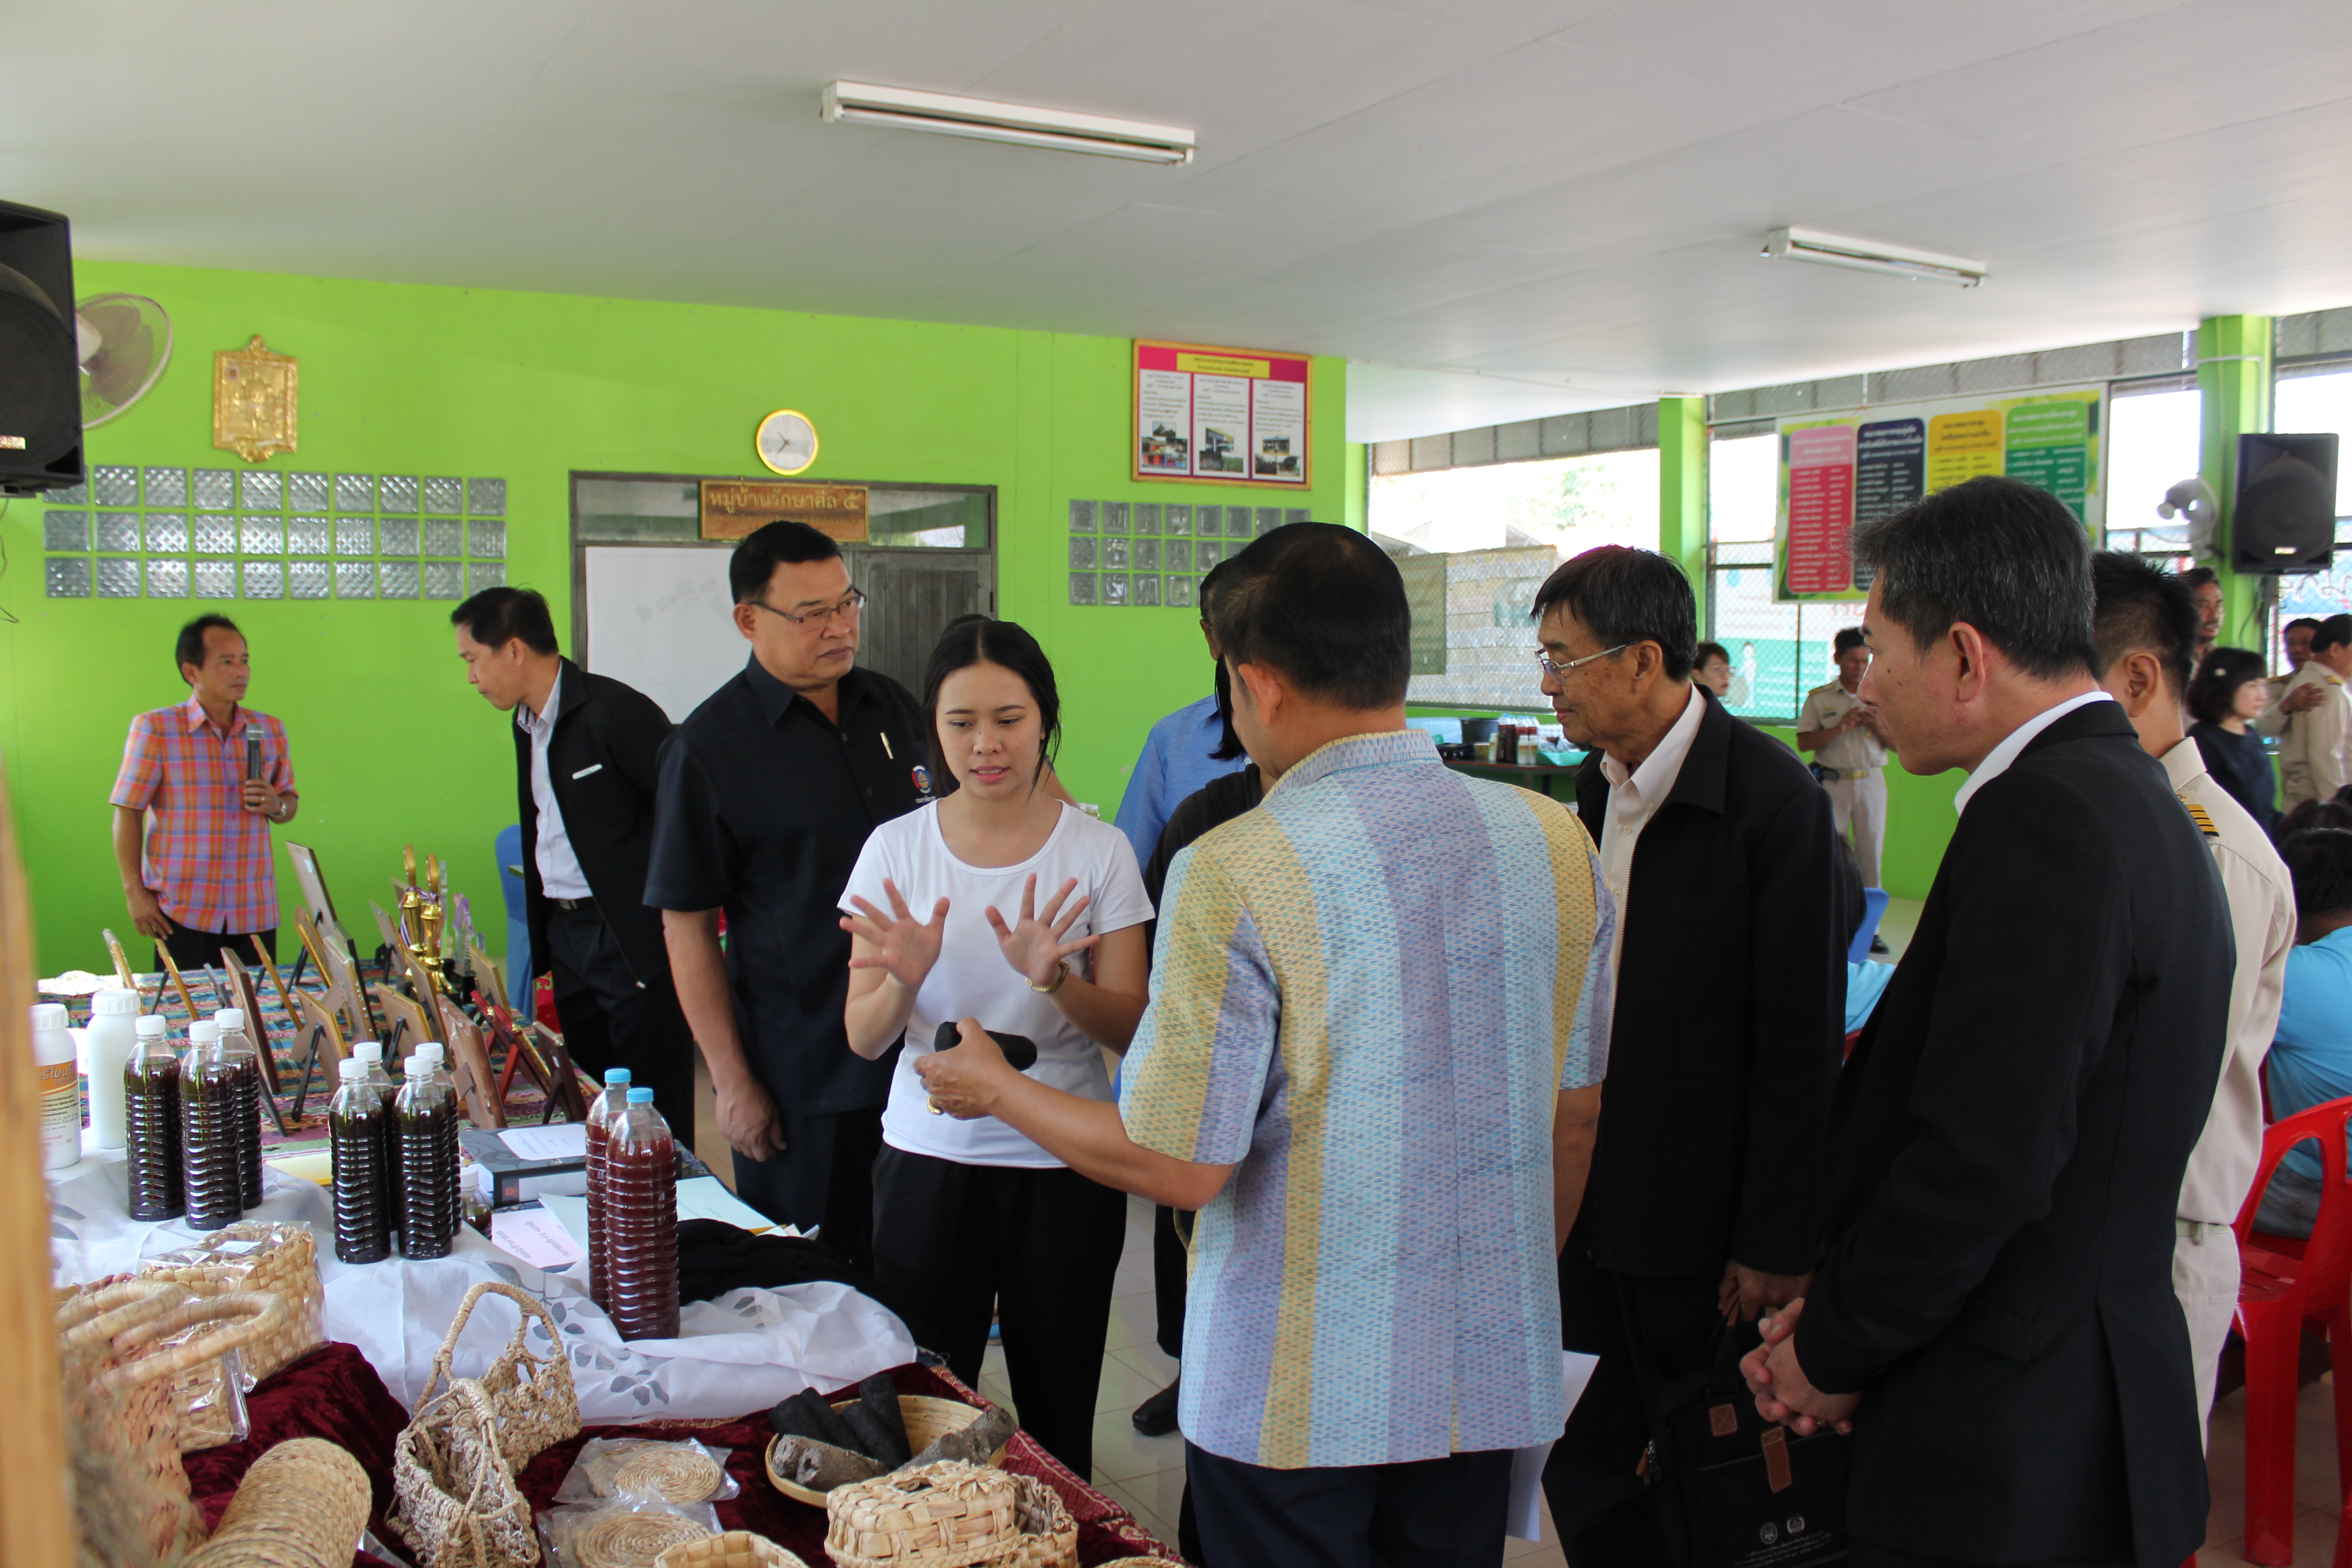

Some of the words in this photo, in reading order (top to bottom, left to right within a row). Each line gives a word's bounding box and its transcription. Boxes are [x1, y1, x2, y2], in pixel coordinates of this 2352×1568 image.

[708, 486, 837, 514] หมู่บ้านรักษาศีล
[843, 492, 861, 511] ๕
